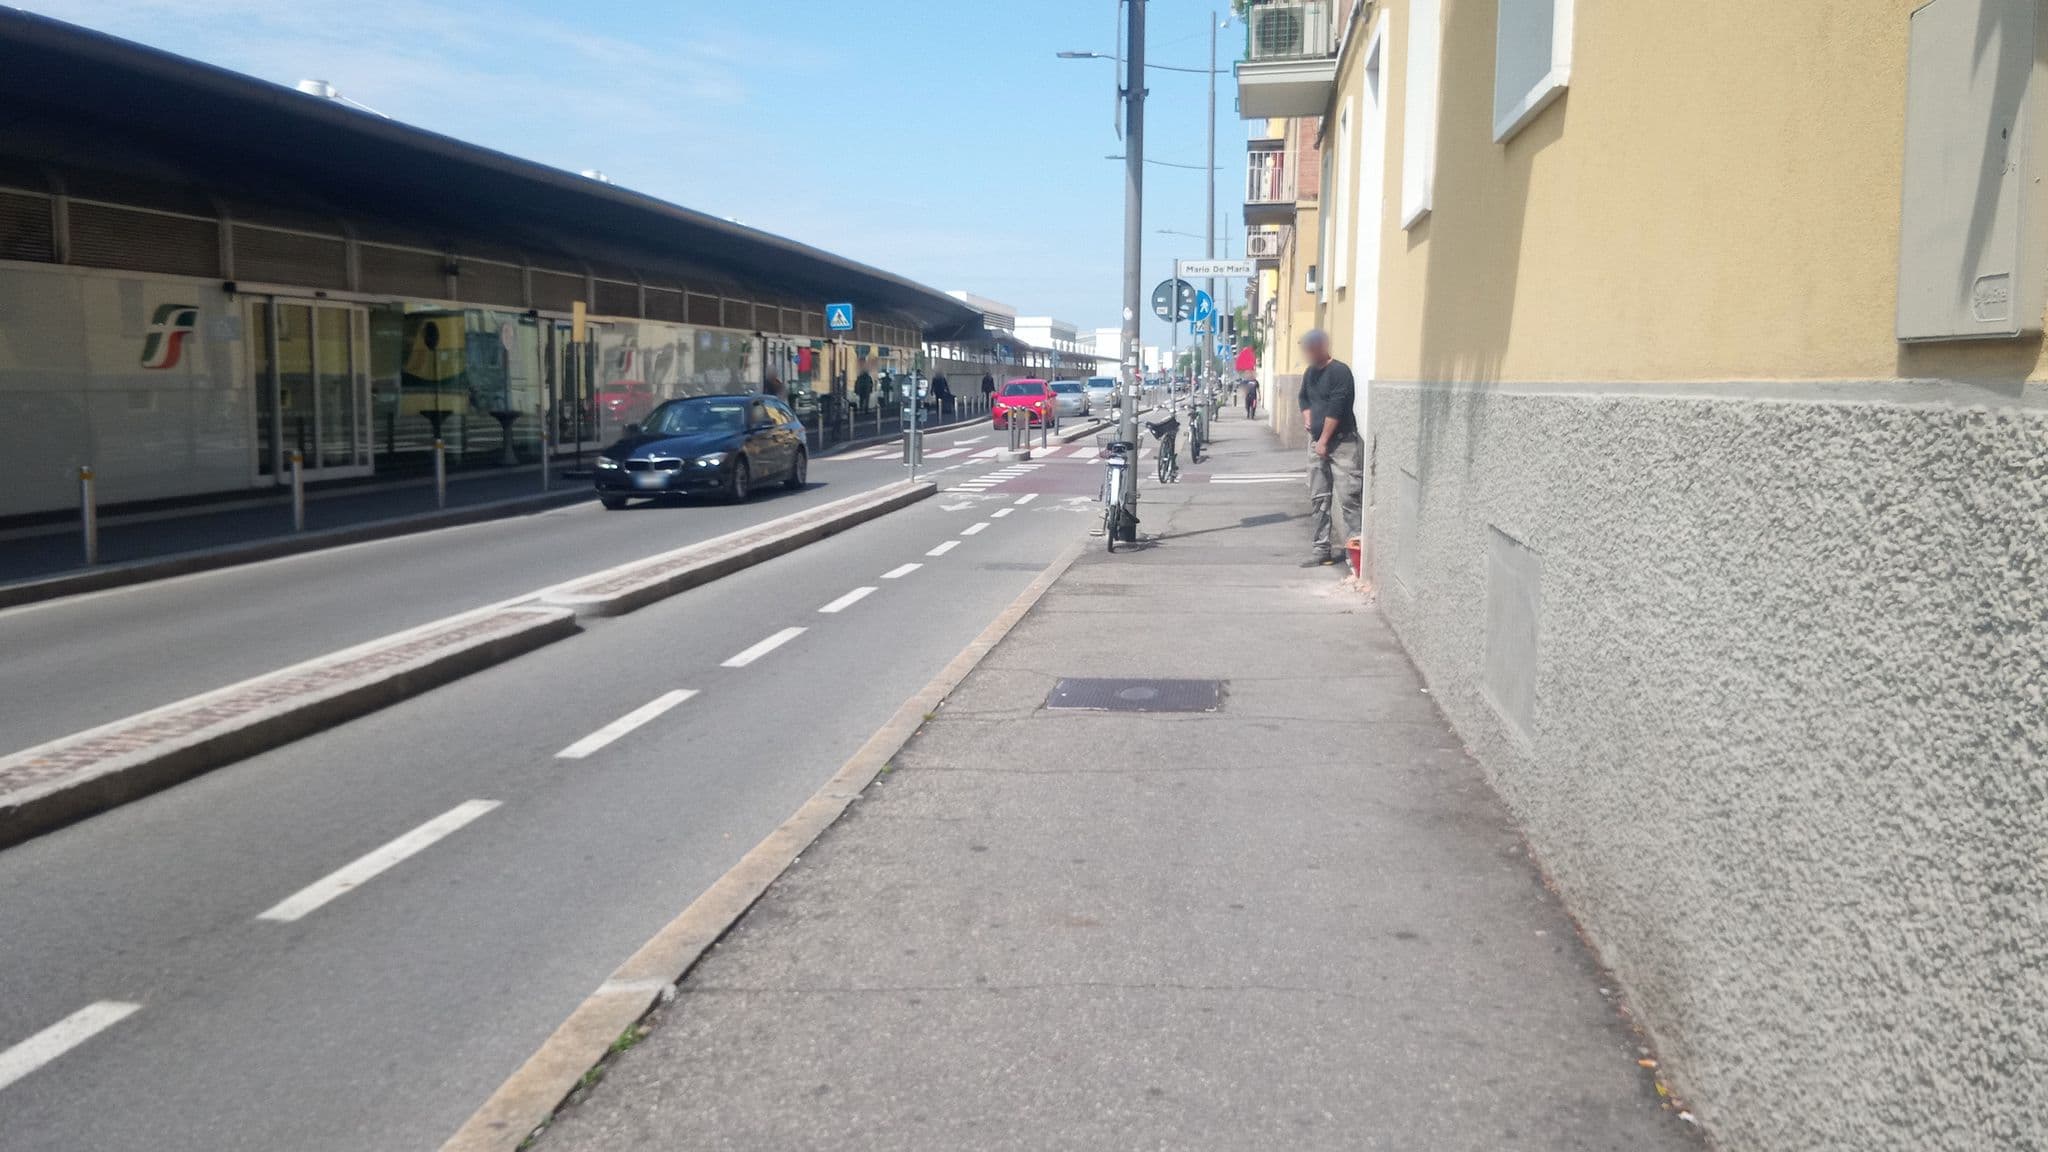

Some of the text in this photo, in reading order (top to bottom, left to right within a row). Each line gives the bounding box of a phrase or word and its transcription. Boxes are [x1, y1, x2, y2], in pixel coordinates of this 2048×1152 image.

[1186, 265, 1250, 273] Mario De Maria
